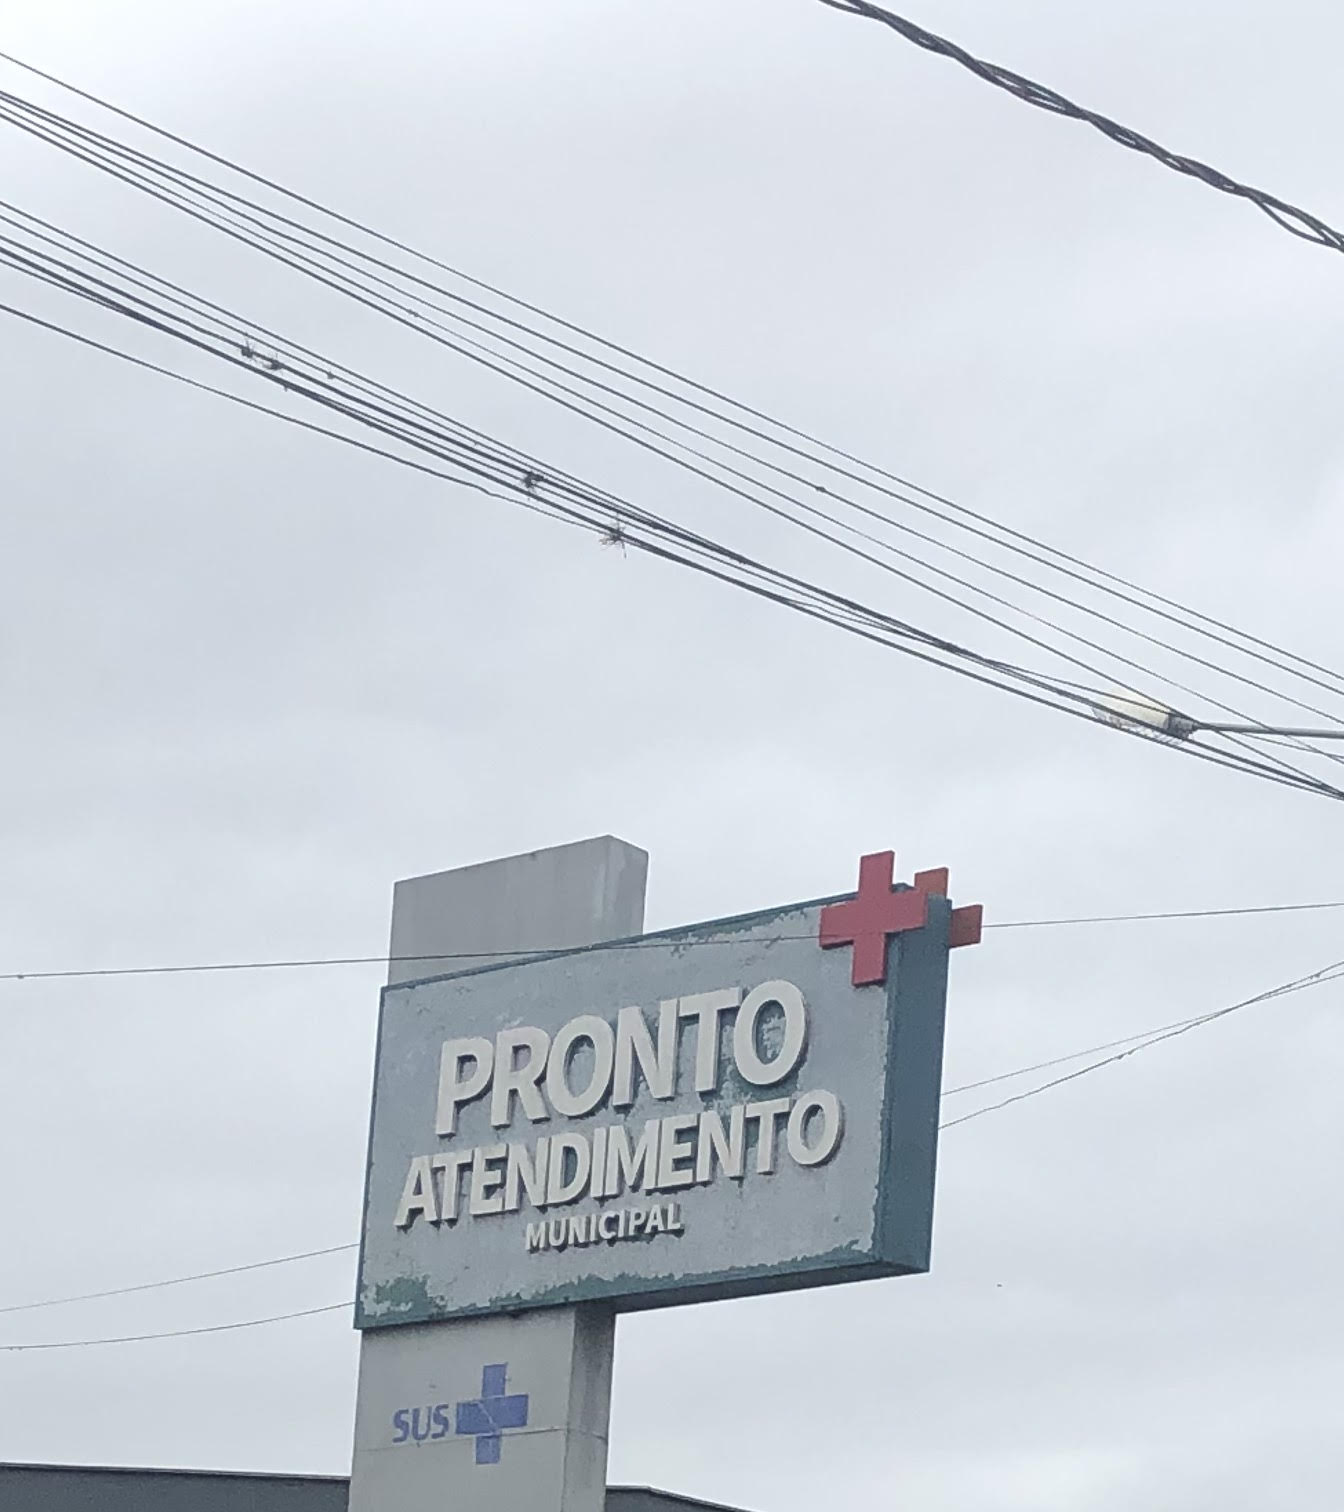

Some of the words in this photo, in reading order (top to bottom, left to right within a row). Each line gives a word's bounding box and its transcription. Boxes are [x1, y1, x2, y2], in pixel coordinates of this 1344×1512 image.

[434, 979, 809, 1137] PRONTO
[393, 1089, 844, 1229] ATENDIMENTO
[524, 1202, 684, 1252] MUNICIPAL
[392, 1403, 450, 1444] SUS
